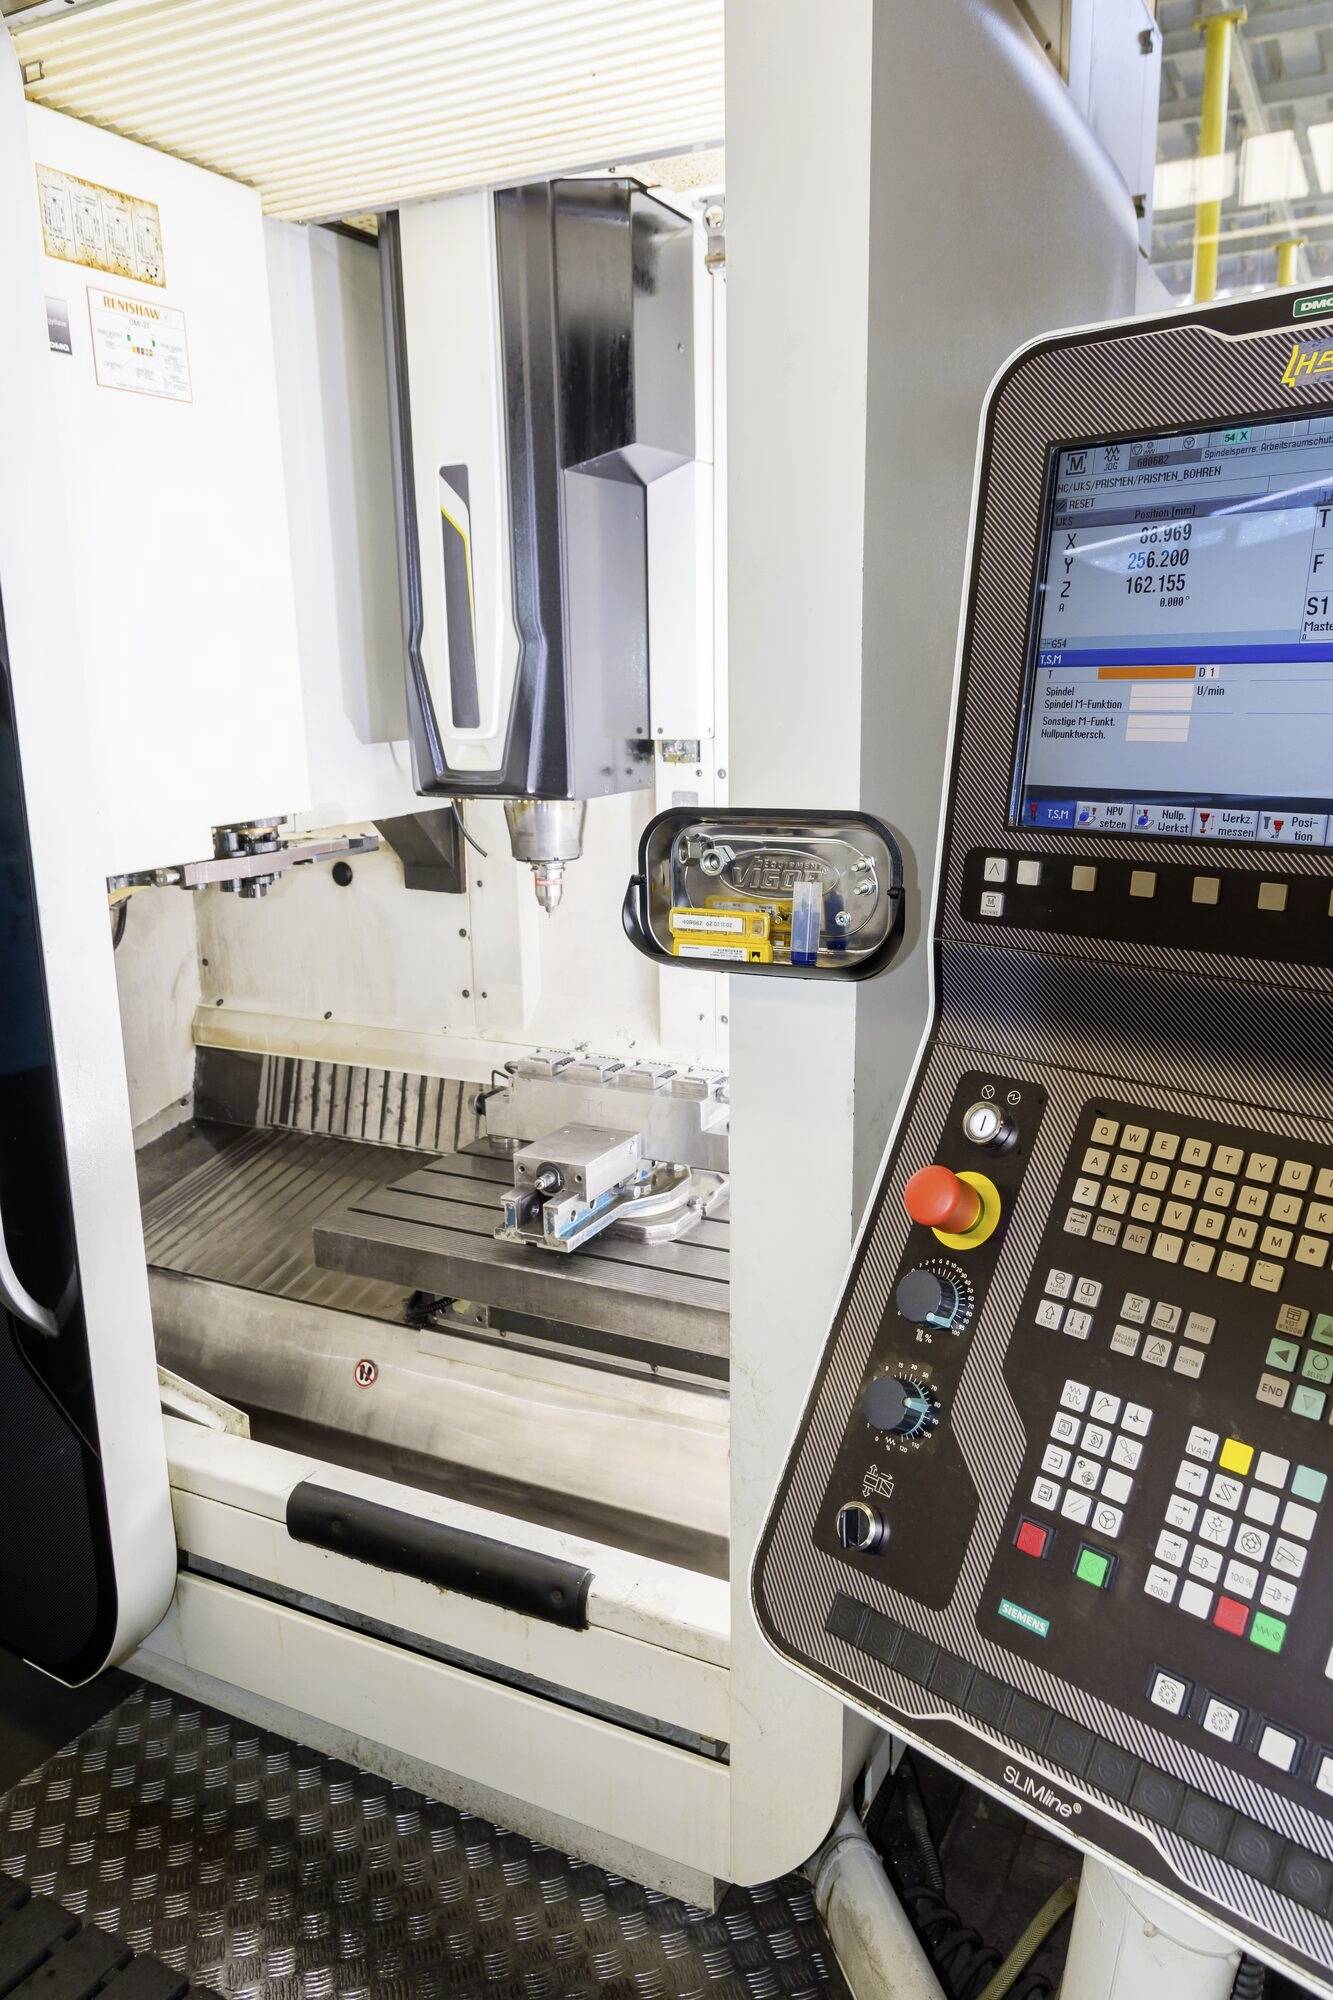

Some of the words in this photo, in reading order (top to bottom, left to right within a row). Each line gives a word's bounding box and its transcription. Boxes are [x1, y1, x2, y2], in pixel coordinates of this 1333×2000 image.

[103, 296, 161, 320] RENISHAW
[1223, 433, 1236, 443] 54
[1204, 445, 1258, 460] Spindelsperre:
[1103, 462, 1119, 472] JOG
[1068, 498, 1096, 510] RESET
[1055, 516, 1074, 527] WKS
[1134, 508, 1169, 520] Position
[1319, 509, 1331, 528] T
[1065, 533, 1078, 550] X
[1064, 557, 1074, 574] Y
[1127, 548, 1190, 570] 256.200
[1312, 554, 1325, 573] F
[1060, 581, 1072, 598] Z
[1125, 573, 1187, 595] 162.155
[1306, 596, 1329, 616] S1
[1051, 639, 1067, 649] G54
[1047, 670, 1054, 679] T
[1198, 667, 1206, 678] D
[1209, 667, 1216, 677] 1
[1045, 686, 1075, 698] Spindel
[1197, 684, 1226, 697] U/min
[1044, 699, 1073, 711] Spindel
[1075, 699, 1123, 710] M-Funktion
[1042, 716, 1076, 728] Sonstige
[1079, 716, 1116, 727] M-Funkt.
[1041, 728, 1106, 741] Nullpunktversch.
[1106, 806, 1124, 816] NPV
[1161, 809, 1187, 822] Nullp.
[1099, 819, 1127, 829] setzen
[1222, 812, 1253, 825] Werkz.
[1291, 816, 1319, 828] Posi-
[1218, 828, 1254, 838] messen
[1294, 830, 1313, 842] tion
[1100, 1126, 1109, 1137] Q
[1128, 1132, 1140, 1143] W
[1160, 1140, 1168, 1151] E
[1192, 1147, 1201, 1158] R
[1090, 1157, 1099, 1167] A
[1224, 1154, 1234, 1165] T
[1120, 1163, 1128, 1174] S
[1258, 1161, 1267, 1173] Y
[1150, 1170, 1158, 1181] D
[1291, 1169, 1302, 1180] U
[1184, 1179, 1192, 1190] F
[1081, 1187, 1090, 1196] Z
[1215, 1187, 1224, 1197] G
[1110, 1193, 1120, 1205] X
[1248, 1195, 1258, 1206] H
[1141, 1202, 1150, 1212] C
[1283, 1204, 1291, 1215] J
[1174, 1210, 1183, 1220] V
[1318, 1212, 1328, 1223] K
[1206, 1218, 1214, 1229] B
[1096, 1224, 1117, 1237] CTRL
[1237, 1227, 1247, 1238] N
[1128, 1233, 1145, 1244] ALT
[1270, 1236, 1282, 1248] M
[1191, 1322, 1209, 1333] OFFSET
[1261, 1383, 1283, 1397] END
[1175, 1515, 1184, 1526] 10
[1163, 1549, 1177, 1562] 100
[1150, 1584, 1169, 1599] 1000
[1001, 1603, 1048, 1633] SIEMENS
